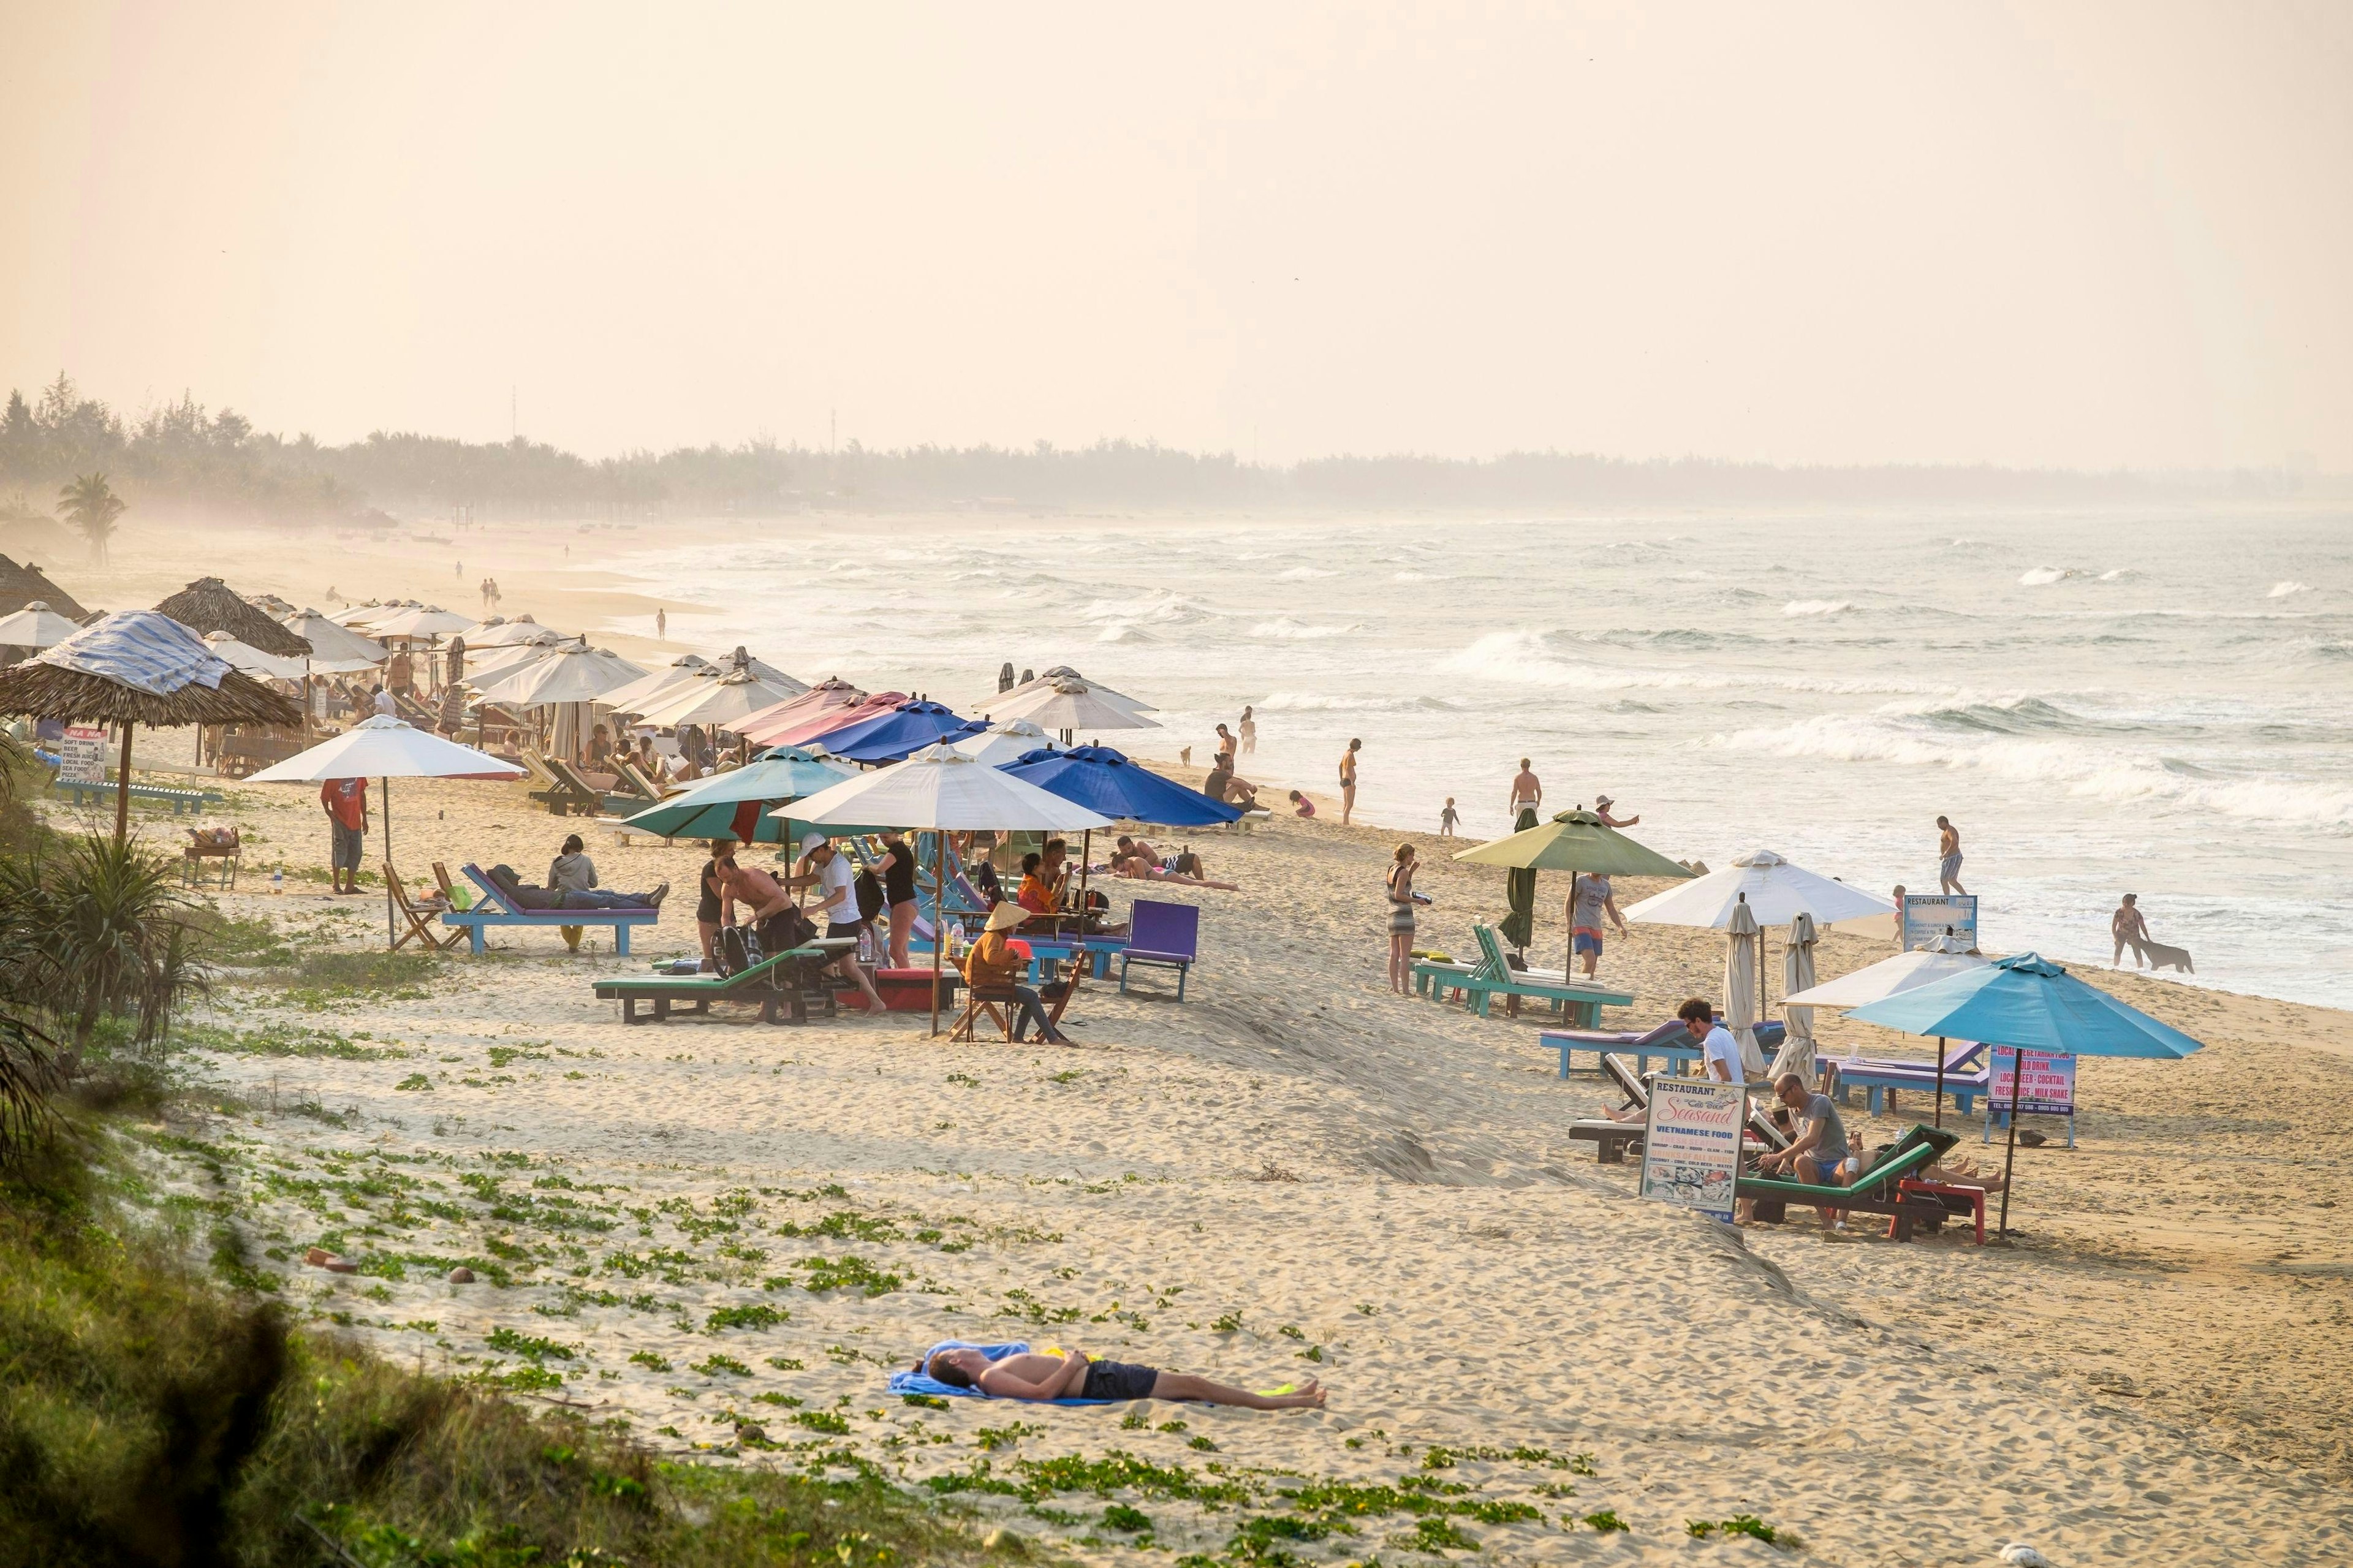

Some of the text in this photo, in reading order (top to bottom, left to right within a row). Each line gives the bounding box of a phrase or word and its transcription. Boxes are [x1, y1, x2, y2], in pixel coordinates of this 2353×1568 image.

[1998, 1046, 2014, 1056] LOCAL
[2021, 1060, 2049, 1071] OLD DRINK
[2000, 1073, 2015, 1083] LOCA
[2037, 1075, 2064, 1085] COCKTAIL
[1657, 1082, 1716, 1096] RESTAURANT
[1995, 1086, 2014, 1096] FRESH
[2034, 1088, 2048, 1097] MILK
[2049, 1089, 2068, 1099] SHAKE
[1657, 1096, 1736, 1126] Seasand
[1657, 1126, 1733, 1139] VIETNAMESE FOOD
[1661, 1135, 1727, 1148] FRESH SEAFOOD
[1651, 1149, 1681, 1158] DRINKS
[1708, 1155, 1733, 1164] KINDS
